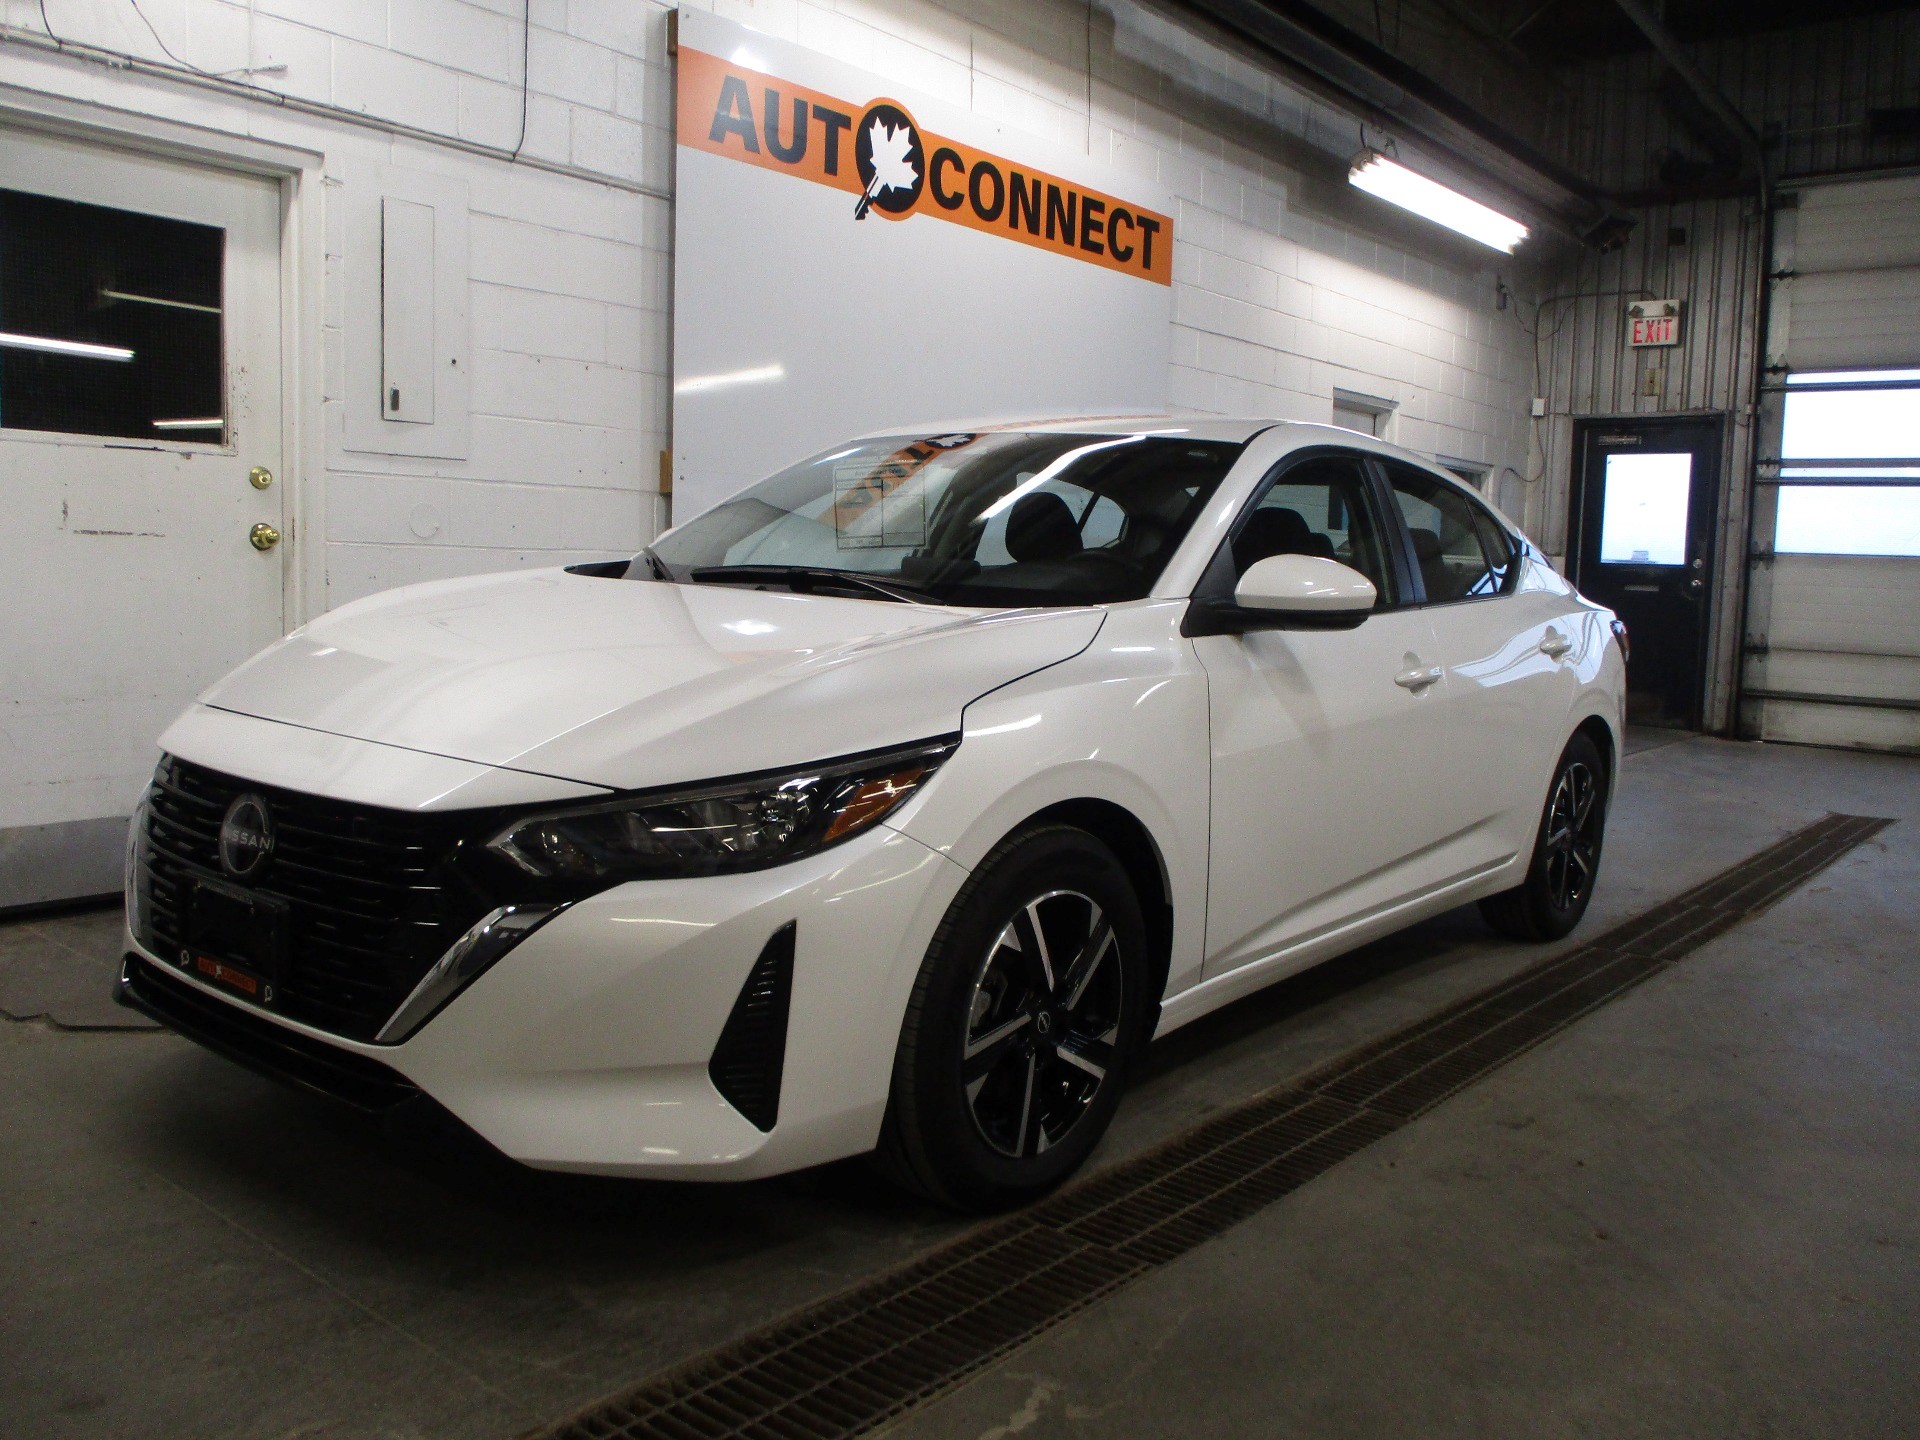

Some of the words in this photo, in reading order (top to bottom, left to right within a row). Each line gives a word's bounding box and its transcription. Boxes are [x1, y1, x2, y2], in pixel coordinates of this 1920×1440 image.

[929, 147, 1160, 270] CONNECT
[1633, 319, 1673, 344] EXIT
[226, 828, 271, 851] SSAN
